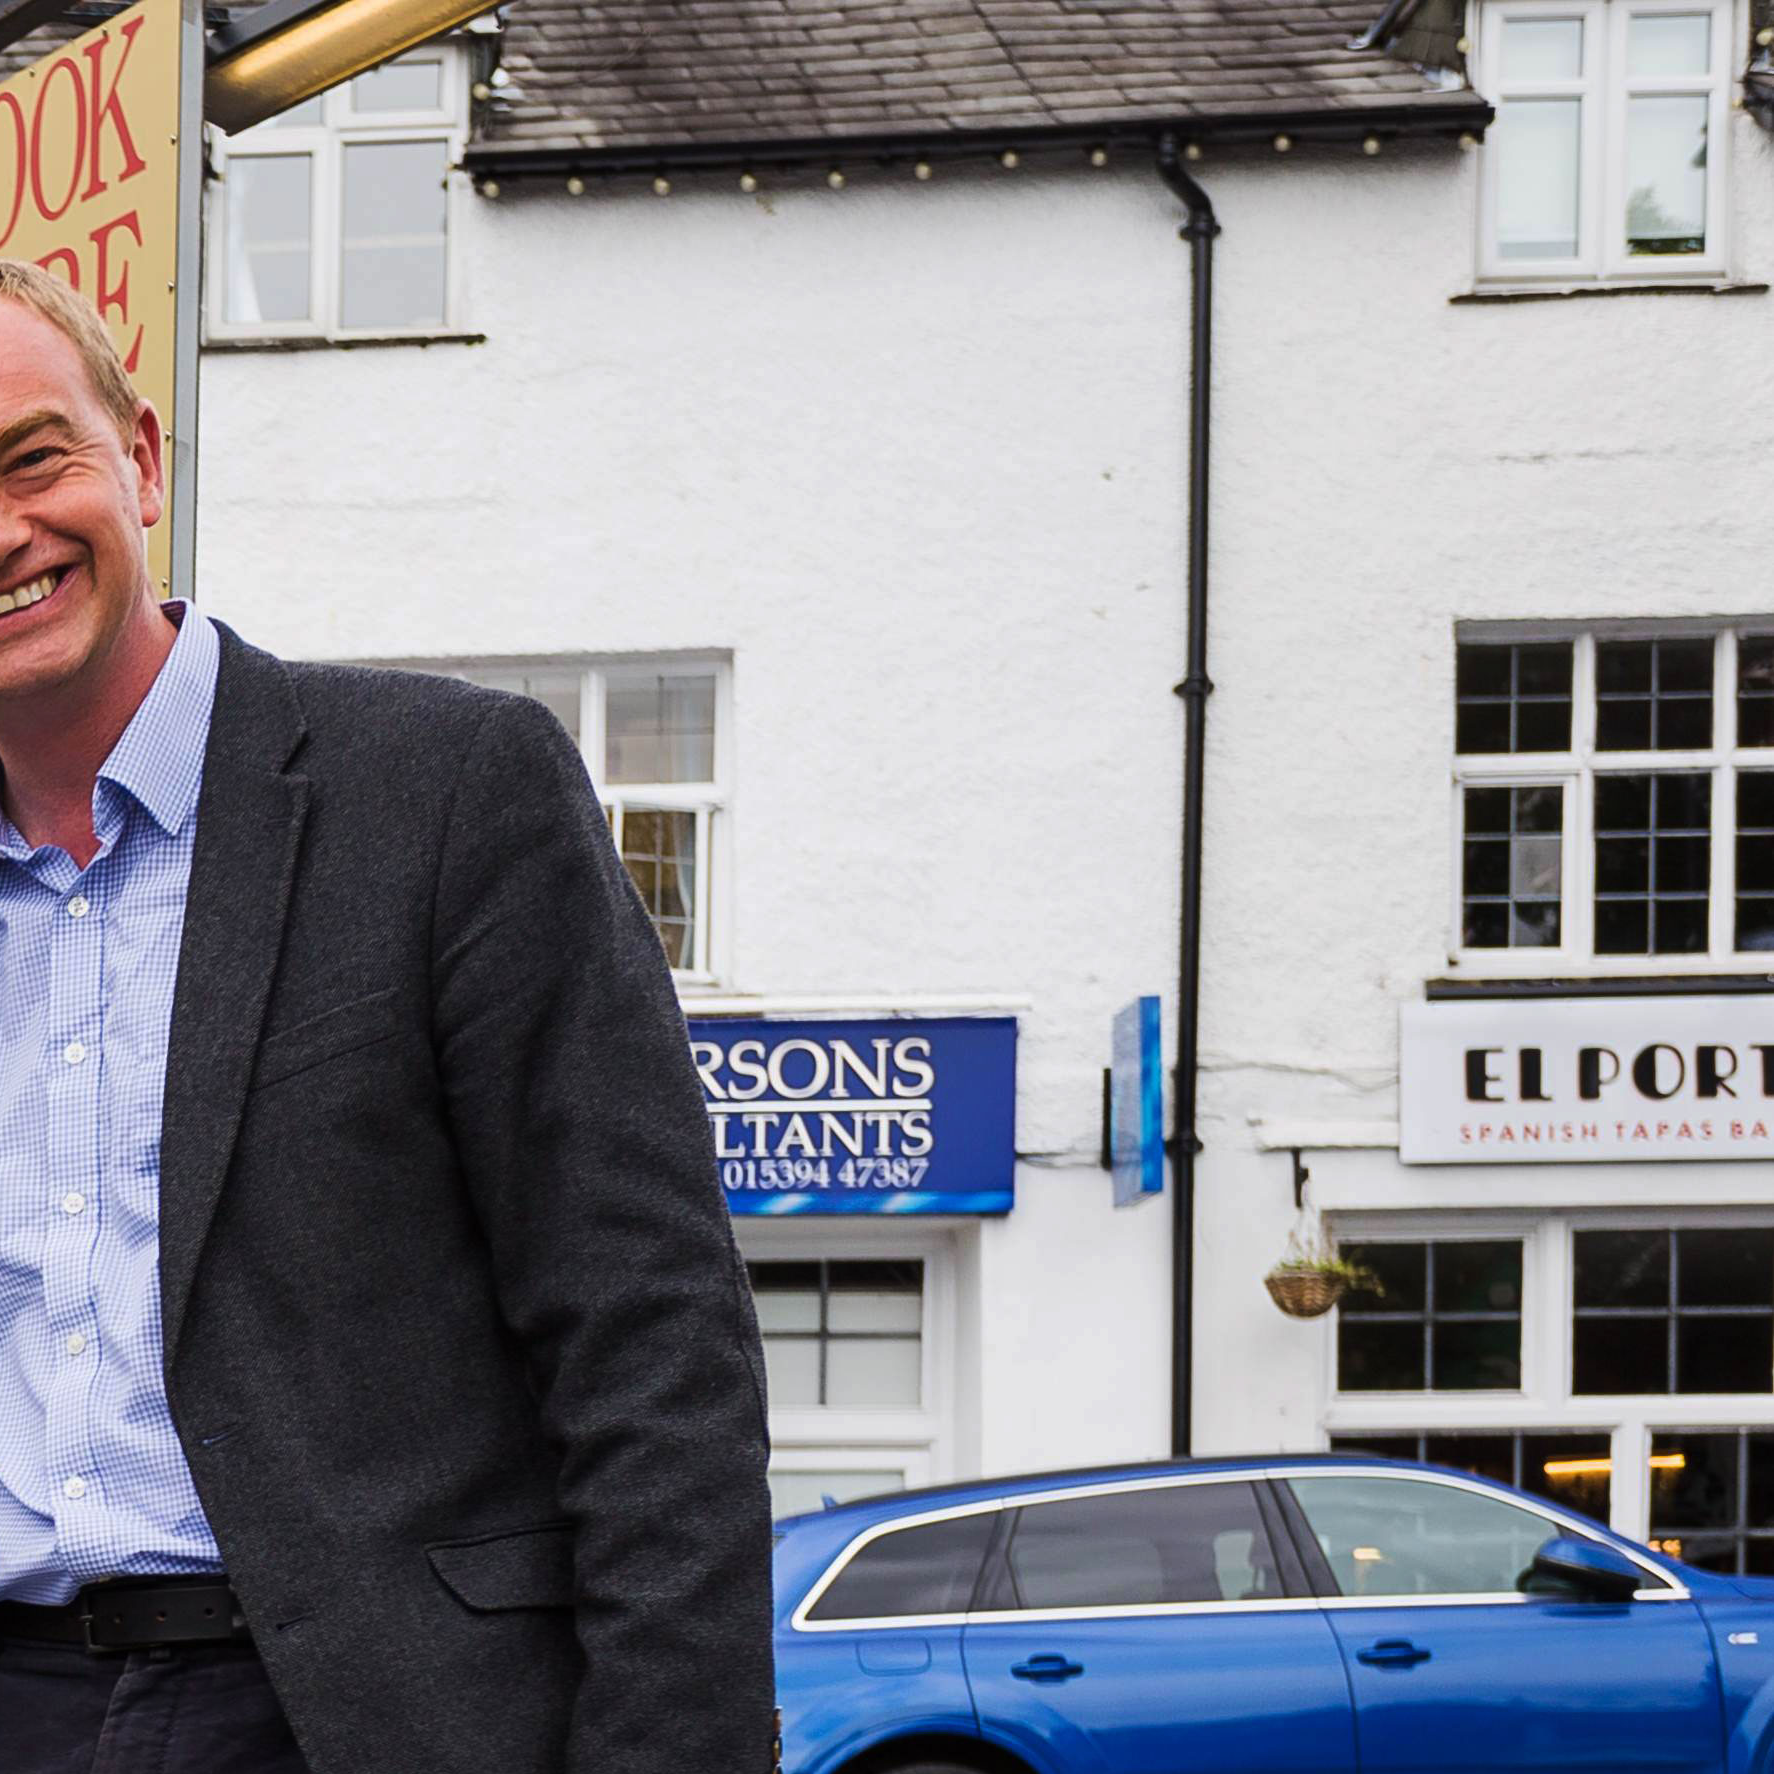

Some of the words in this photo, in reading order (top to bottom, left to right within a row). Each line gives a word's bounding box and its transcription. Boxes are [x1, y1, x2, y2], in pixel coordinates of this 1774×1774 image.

[689, 1037, 935, 1100] RSONS
[1464, 1046, 1554, 1103] EL
[708, 1110, 934, 1158] LTANTS
[1459, 1120, 1600, 1143] SPANISH
[1615, 1118, 1714, 1140] TAPAS
[1729, 1118, 1769, 1139] BA
[723, 1158, 831, 1190] 015394
[837, 1157, 930, 1188] 47387
